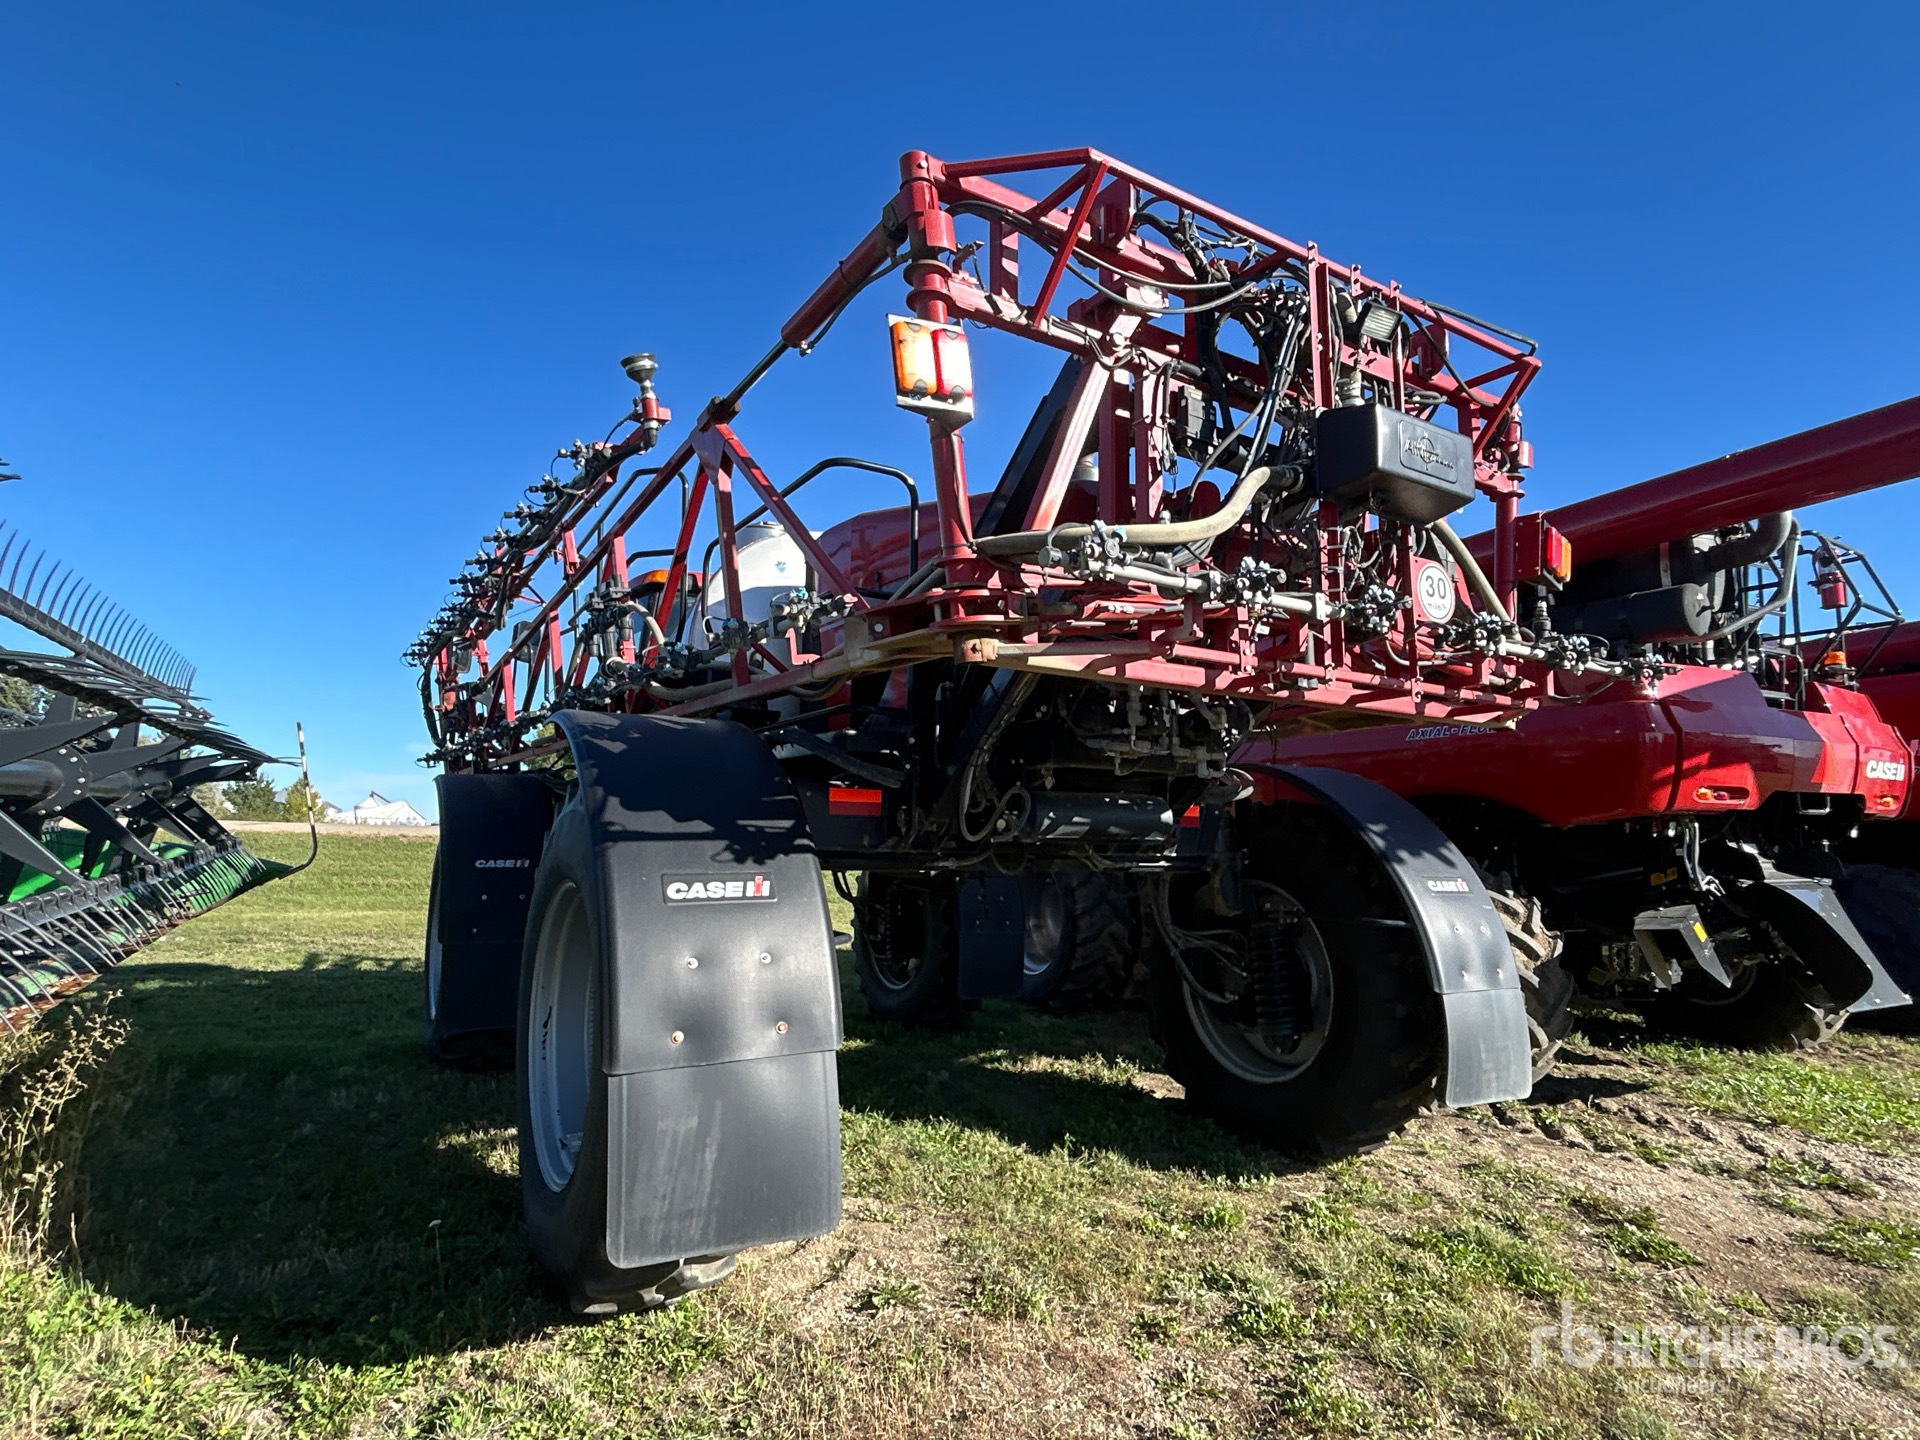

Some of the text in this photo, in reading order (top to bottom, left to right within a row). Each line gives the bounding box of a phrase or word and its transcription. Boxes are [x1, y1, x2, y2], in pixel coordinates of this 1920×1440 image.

[1425, 575, 1447, 600] 30
[1866, 760, 1897, 780] CASE
[475, 859, 516, 868] CASE
[667, 881, 745, 900] CASE
[1427, 880, 1458, 892] CASE
